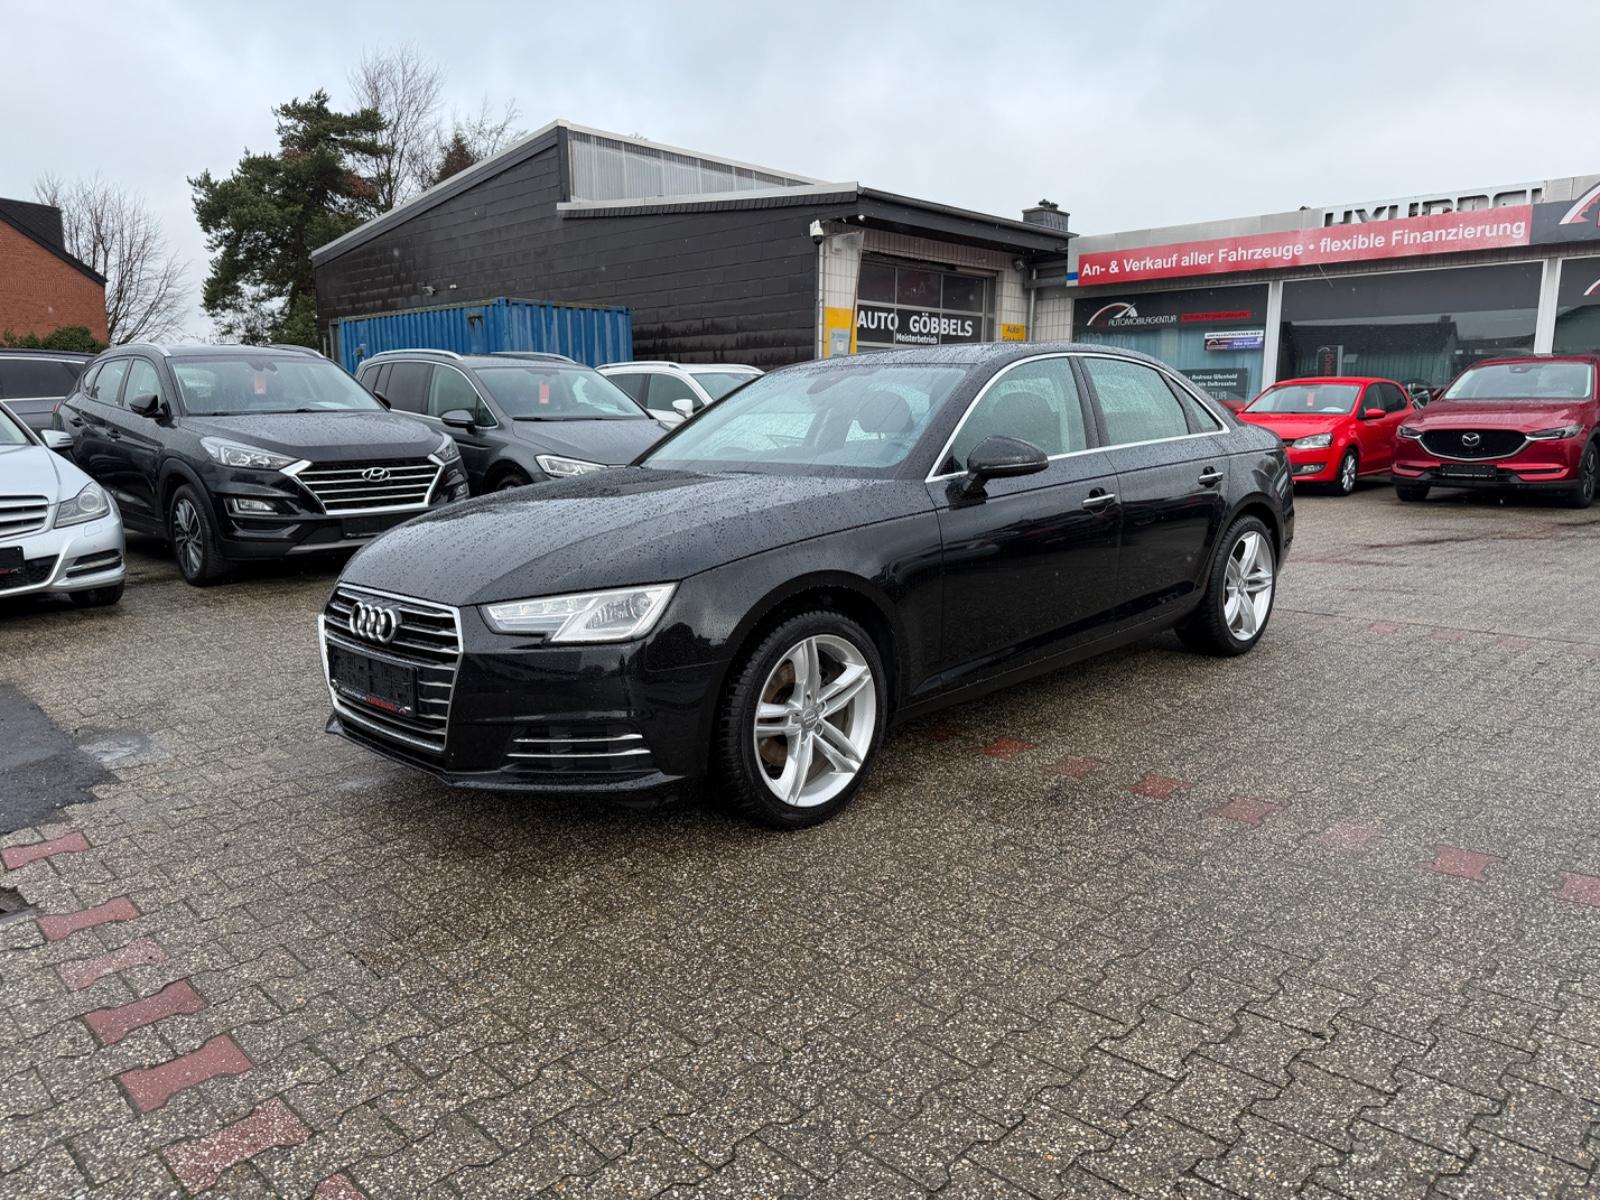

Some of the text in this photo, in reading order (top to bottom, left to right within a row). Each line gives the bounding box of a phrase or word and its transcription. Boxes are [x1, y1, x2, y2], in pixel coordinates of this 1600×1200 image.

[1082, 221, 1526, 277] An- & Verkauf aller Fahrzeuge flexible Finanzierung
[857, 310, 973, 336] AUTO GÖBBELS
[896, 333, 938, 344] Meisterbetrieb
